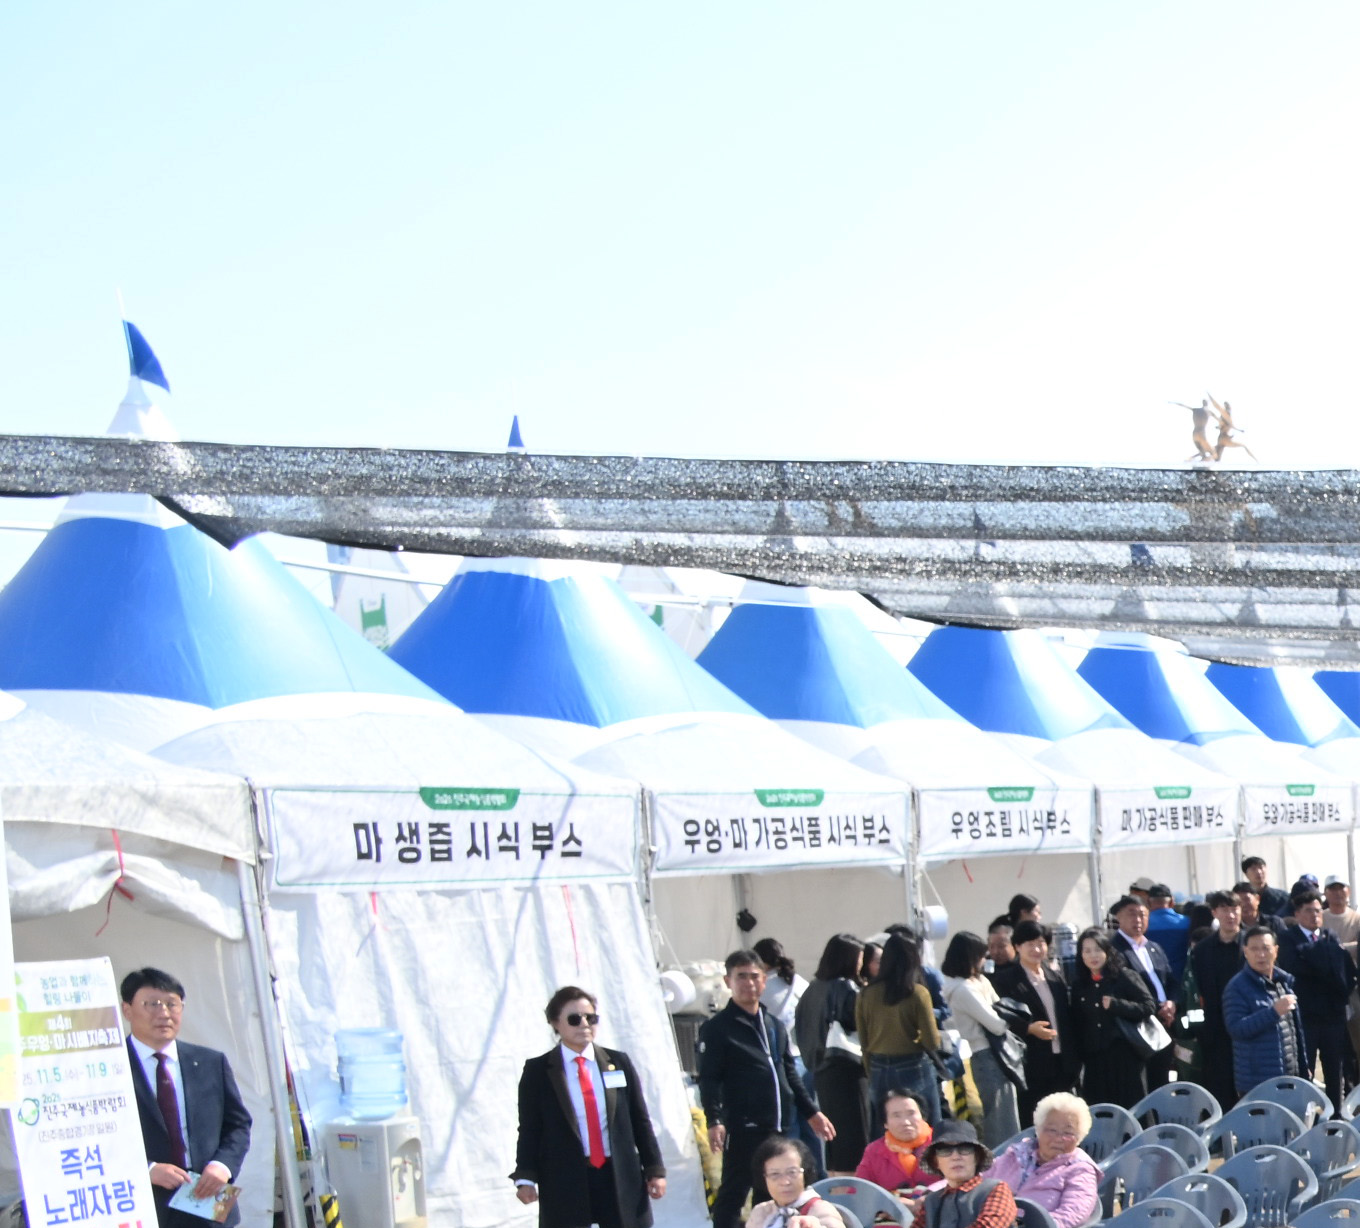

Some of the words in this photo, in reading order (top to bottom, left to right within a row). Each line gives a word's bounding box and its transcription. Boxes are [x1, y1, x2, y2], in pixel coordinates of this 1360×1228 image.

[1121, 809, 1133, 832] 마
[1135, 806, 1179, 832] 가공식품
[1182, 805, 1202, 829] 판매
[1206, 803, 1224, 828] 부스
[1280, 802, 1309, 824] 가공식품
[353, 821, 383, 863] 마
[395, 821, 454, 864] 생즙
[466, 821, 521, 861] 시식
[531, 821, 583, 859] 부스
[683, 817, 748, 855] 우엉·마
[752, 816, 822, 850] 가공식품
[42, 1096, 127, 1121] 진주국제농식품박람회
[60, 1144, 104, 1180] 즉석
[43, 1180, 135, 1226] 노래자랑
